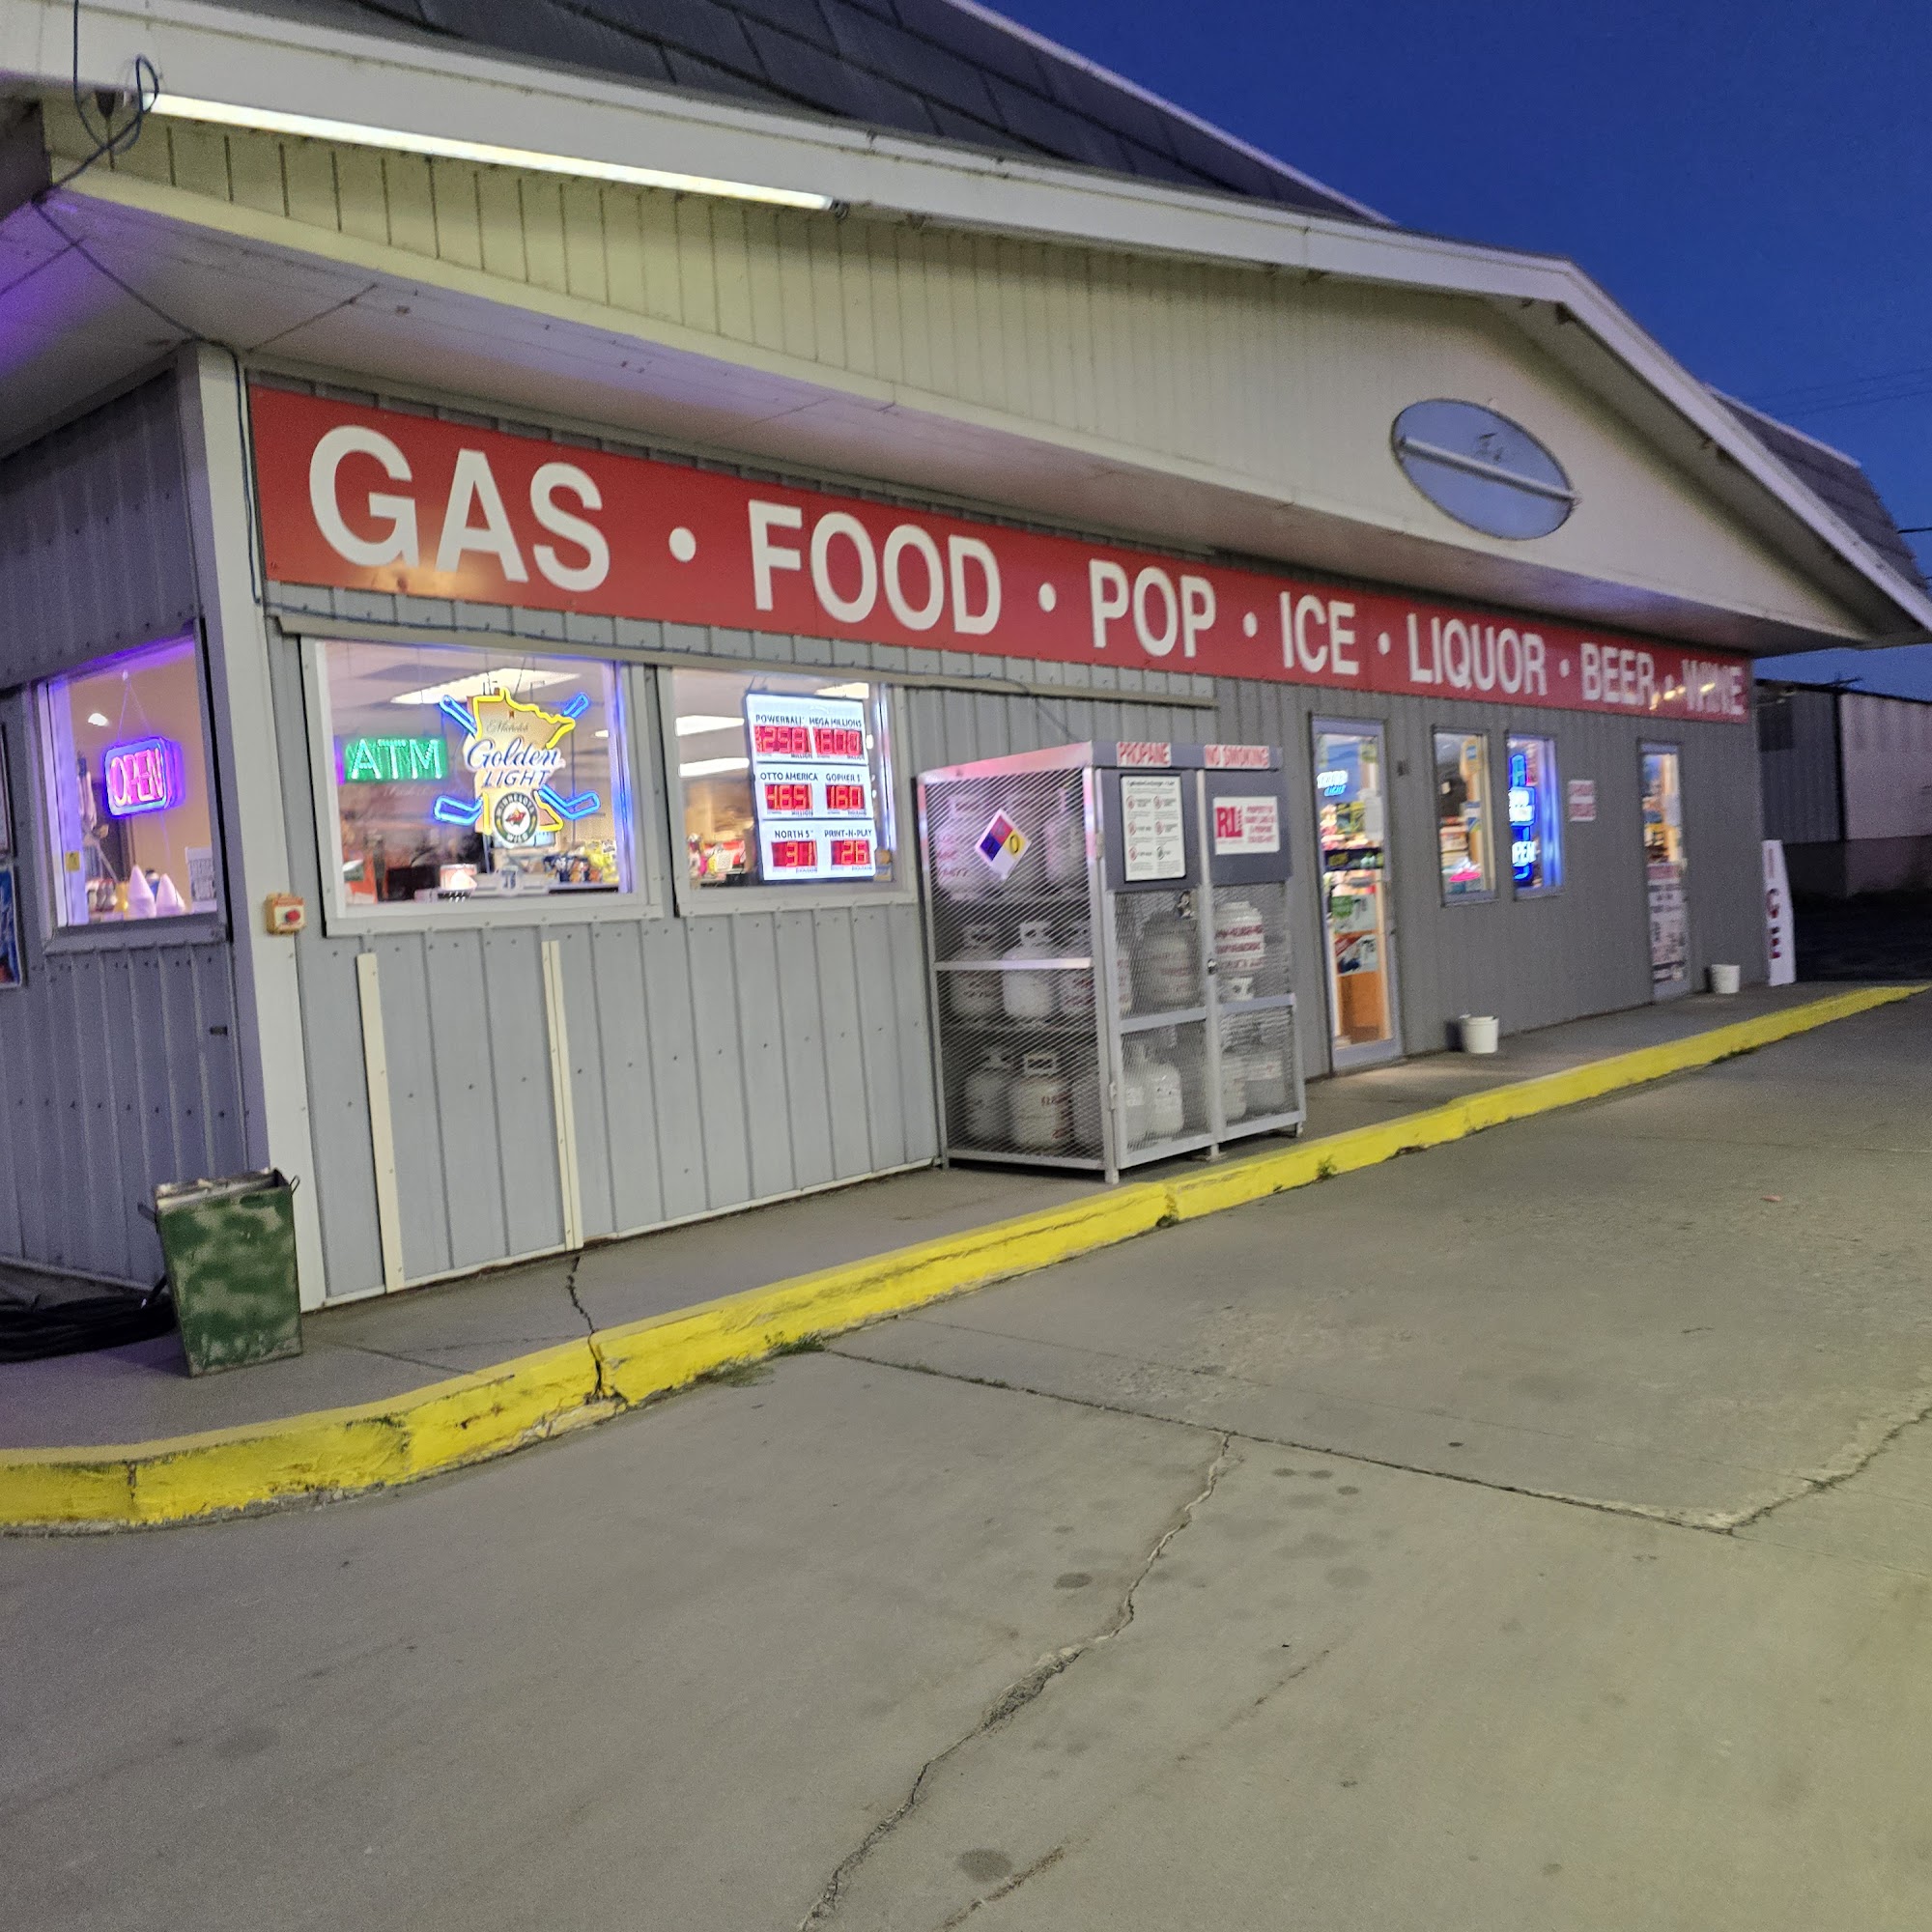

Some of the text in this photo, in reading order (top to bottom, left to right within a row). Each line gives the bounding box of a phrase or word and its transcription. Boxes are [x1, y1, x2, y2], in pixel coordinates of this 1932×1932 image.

[308, 425, 611, 592] GAS
[748, 499, 1002, 636] FOOD
[1089, 558, 1217, 659] POP
[1279, 591, 1360, 676] ICE
[1406, 612, 1548, 697] LIQUOR
[1580, 642, 1655, 707] BEER
[755, 714, 802, 725] POWERBALL
[809, 717, 830, 727] MEGA
[350, 739, 442, 780] ATM
[467, 737, 558, 769] Golden
[110, 748, 164, 806] OPEN
[482, 770, 551, 788] LIGHT
[784, 772, 818, 781] AMERICA
[774, 830, 804, 838] NORTH
[1511, 839, 1537, 866] PEN
